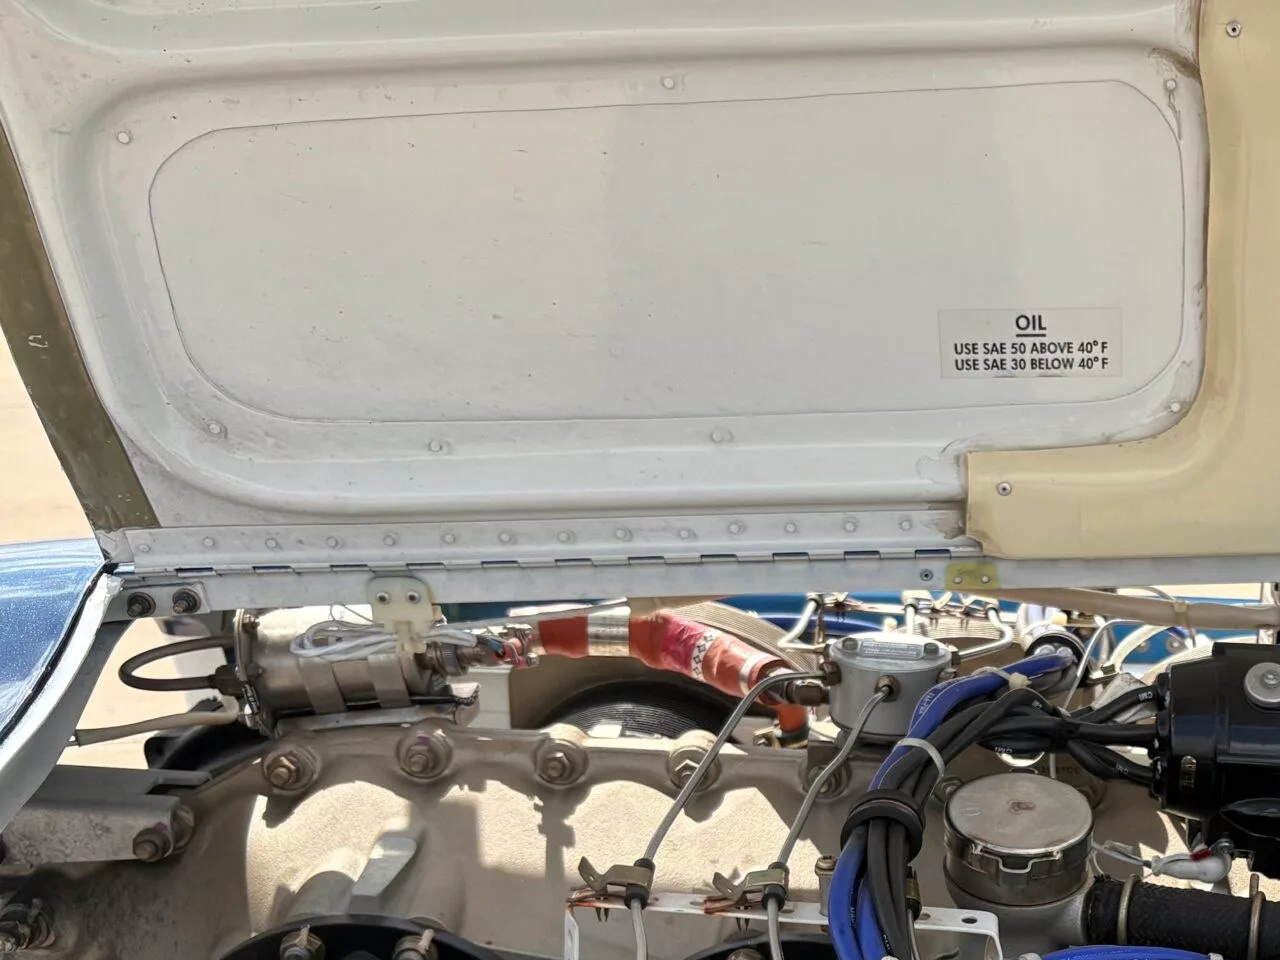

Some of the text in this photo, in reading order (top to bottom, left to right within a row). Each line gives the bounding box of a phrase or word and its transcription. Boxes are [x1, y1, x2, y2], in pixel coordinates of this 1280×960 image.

[1015, 314, 1047, 331] OIL
[954, 343, 979, 355] USE
[983, 342, 1007, 355] SAE
[1010, 342, 1027, 354] 50
[1030, 341, 1074, 354] ABOVE
[955, 359, 980, 371] USE
[983, 358, 1007, 370] SAE
[1011, 358, 1027, 370] 30
[1030, 358, 1075, 370] BELOW
